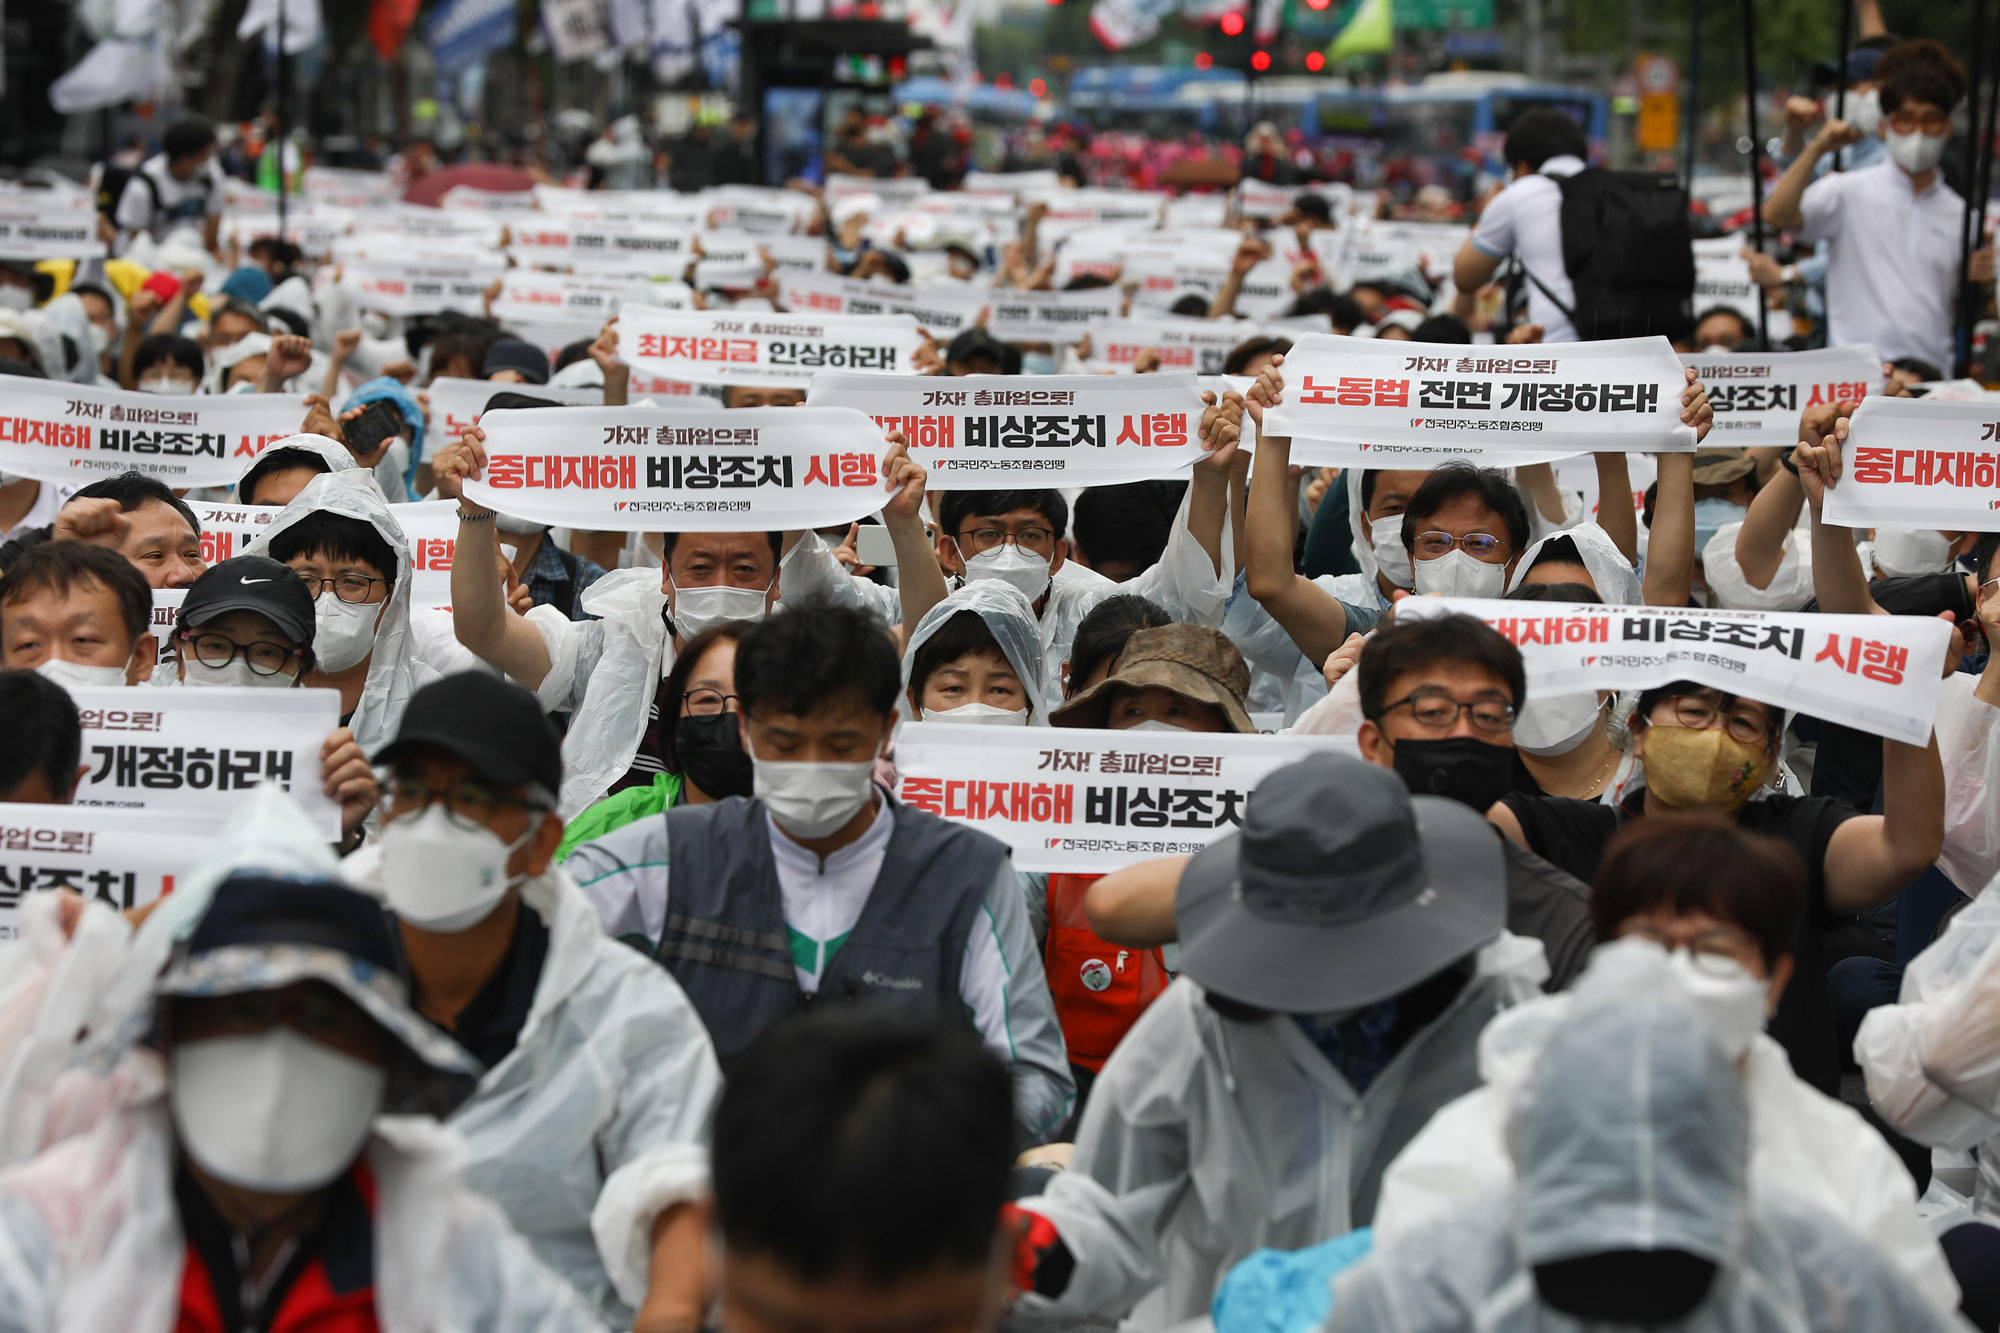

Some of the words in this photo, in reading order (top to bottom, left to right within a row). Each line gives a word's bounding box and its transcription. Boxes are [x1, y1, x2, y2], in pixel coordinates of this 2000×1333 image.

[638, 333, 758, 363] 최저임금
[768, 341, 896, 370] 인상하라!
[1404, 356, 1450, 372] 가자!
[1456, 357, 1560, 375] 총파업으로!
[923, 390, 967, 407] 가자!
[974, 390, 1076, 406] 총파업으로!
[1300, 375, 1410, 408] 노동법
[1419, 379, 1492, 410] 전면
[1499, 383, 1659, 413] 개정하라!
[65, 400, 103, 419] 가자!
[110, 404, 199, 426] 총파업으로!
[1425, 418, 1543, 431] 전국민주노동조합총연맹
[99, 428, 225, 459] 비상조치
[603, 426, 649, 446] 가자!
[655, 426, 760, 446] 총파업으로!
[869, 415, 954, 448] 재해
[964, 415, 1106, 448] 비상조치
[1116, 413, 1188, 447] 시행
[488, 455, 637, 490] 중대재해
[646, 455, 793, 489] 비상조치
[803, 453, 878, 488] 시행
[947, 459, 1065, 470] 전국민주노동조합총연맹
[203, 510, 248, 523] 가자!
[628, 501, 752, 512] 전국민주노동조합총연맹
[1623, 617, 1804, 660] 비상조치
[1814, 632, 1909, 687] 시행
[90, 745, 293, 792] 개정하라!
[1038, 749, 1092, 772] 가자!
[1100, 750, 1225, 777] 총파업으로!
[900, 777, 1074, 825] 중대재해
[0, 827, 94, 854] 업으로!
[1063, 838, 1205, 853] 전국민주노동조합총연맹
